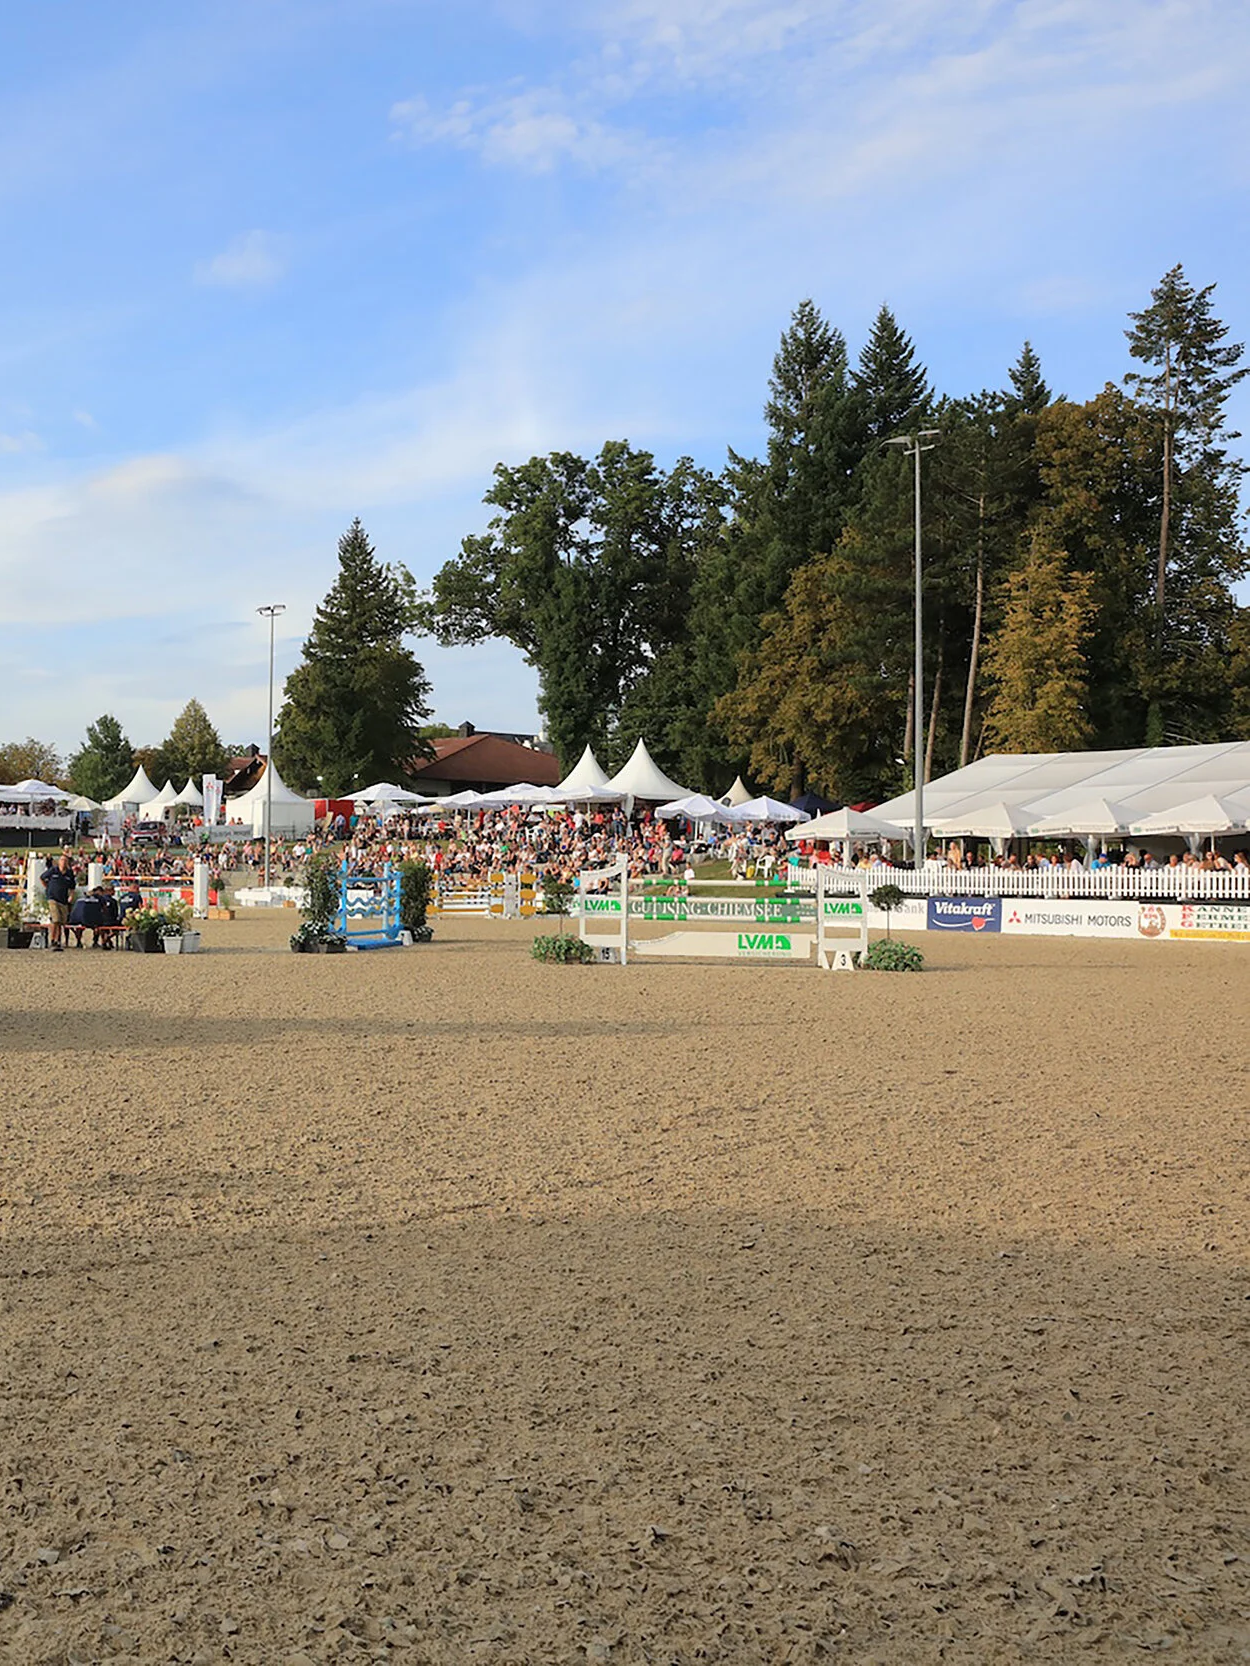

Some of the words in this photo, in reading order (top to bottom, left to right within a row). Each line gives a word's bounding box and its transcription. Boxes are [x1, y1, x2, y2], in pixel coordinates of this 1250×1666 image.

[584, 900, 609, 911] LVM
[632, 901, 659, 914] GUT
[662, 901, 701, 915] ISING
[707, 902, 783, 917] CHIEMSEE
[824, 902, 850, 914] LVM
[934, 901, 994, 916] Vitakraft
[1181, 904, 1247, 913] KANNE
[1024, 913, 1083, 926] MITSUBISHI
[1087, 914, 1132, 928] MOTORS
[738, 934, 773, 950] LVM
[601, 946, 611, 961] 15
[840, 953, 847, 967] 3
